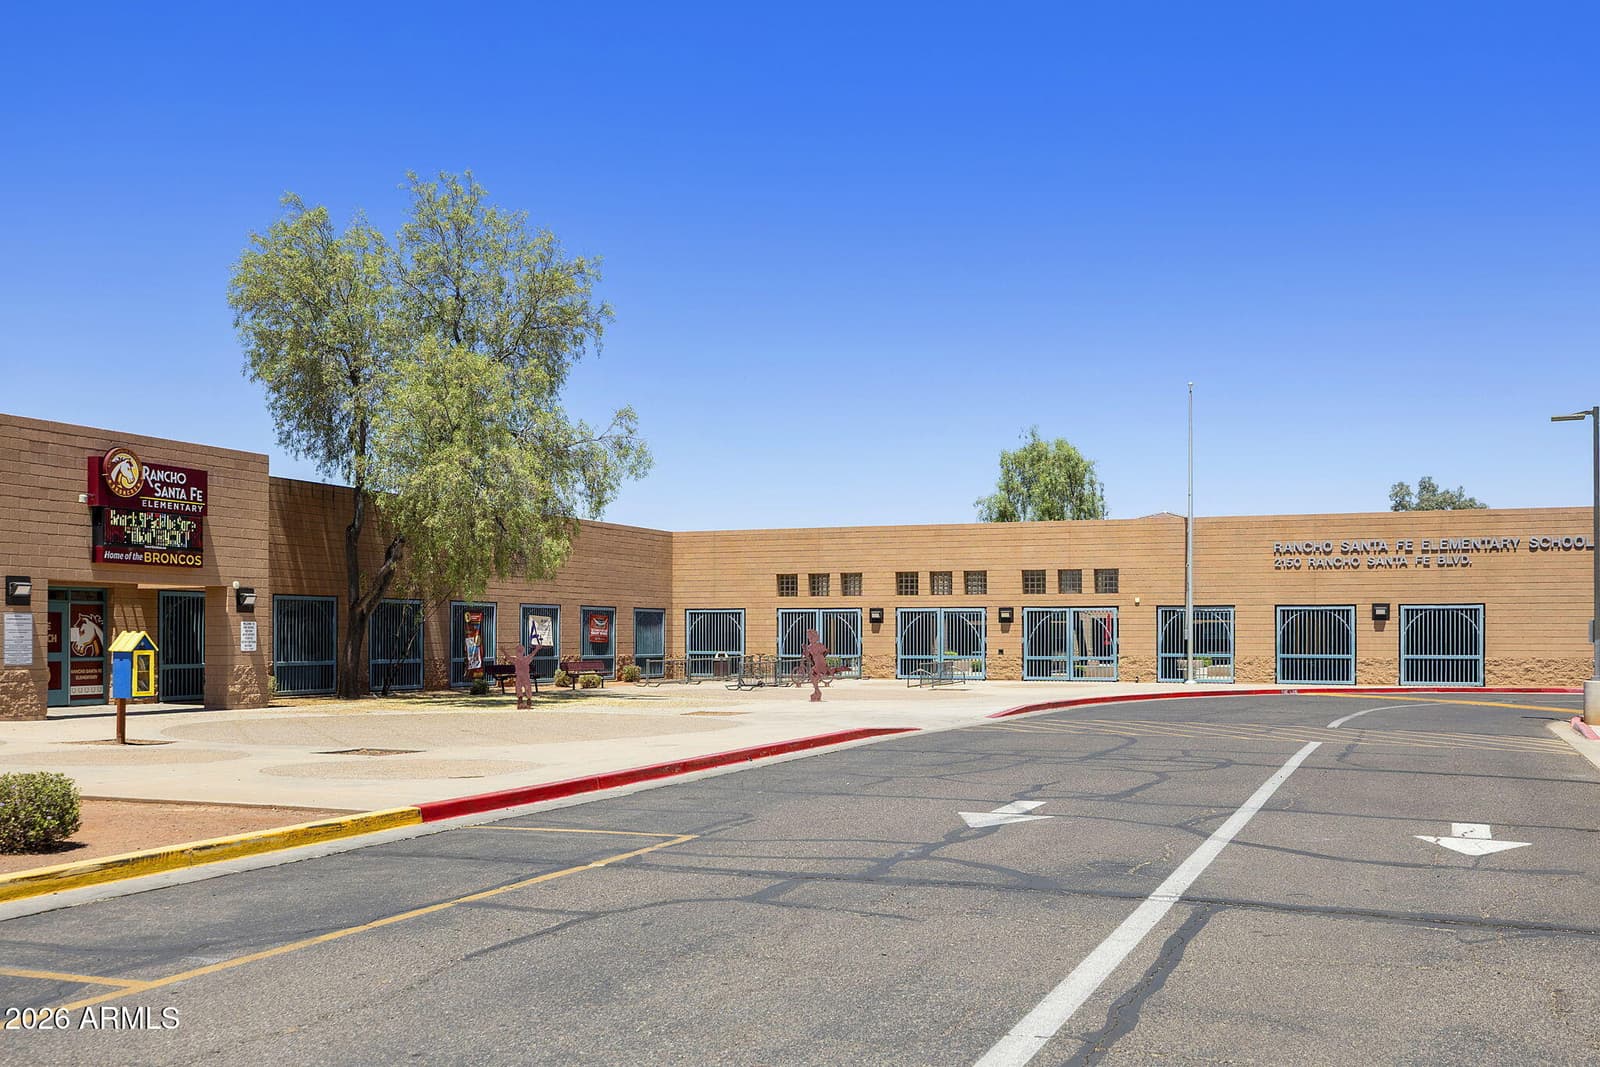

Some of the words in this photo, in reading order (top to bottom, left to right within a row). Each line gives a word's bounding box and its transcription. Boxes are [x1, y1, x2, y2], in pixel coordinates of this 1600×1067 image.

[142, 465, 187, 488] RANCHO
[154, 483, 187, 500] SANTA
[190, 487, 203, 502] FE
[142, 500, 204, 513] ELEMENTARY
[1273, 540, 1333, 555] RANCHO
[1340, 539, 1388, 554] SANTA
[1396, 539, 1414, 553] FE
[1421, 536, 1520, 552] ELEMENTARY
[1529, 536, 1595, 551] SCHOOL
[104, 550, 124, 560] Home
[124, 551, 132, 560] of
[133, 551, 144, 561] the
[144, 551, 202, 566] BRONCOS
[1274, 557, 1302, 569] 2150
[1308, 557, 1360, 569] RANCHO
[1367, 556, 1408, 568] SANTA
[1415, 556, 1431, 567] FE
